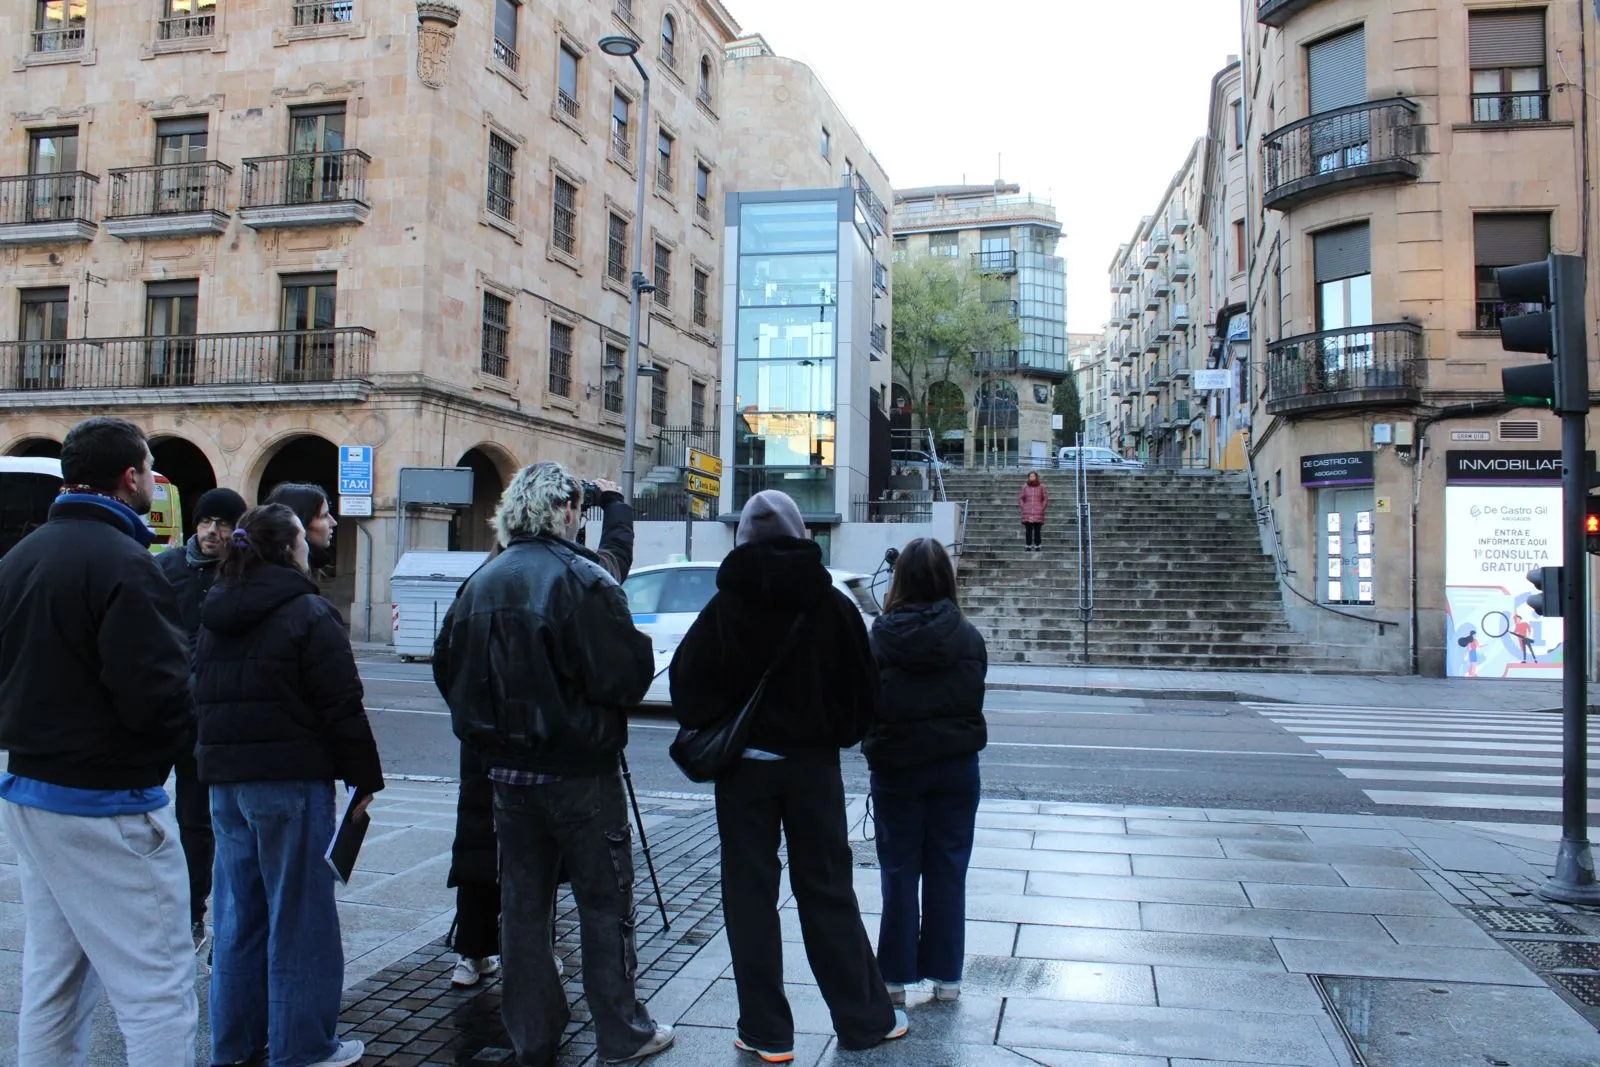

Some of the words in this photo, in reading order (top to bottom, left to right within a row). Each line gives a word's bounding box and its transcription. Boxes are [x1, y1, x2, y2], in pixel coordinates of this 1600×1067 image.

[1313, 458, 1346, 467] CASTRO
[342, 480, 368, 489] TAXI
[1484, 506, 1497, 514] De
[1500, 506, 1532, 515] Castro
[1535, 506, 1548, 515] Gil
[152, 513, 160, 521] 20
[1485, 549, 1548, 560] CONSULTA
[1481, 562, 1540, 572] GRATUITA
